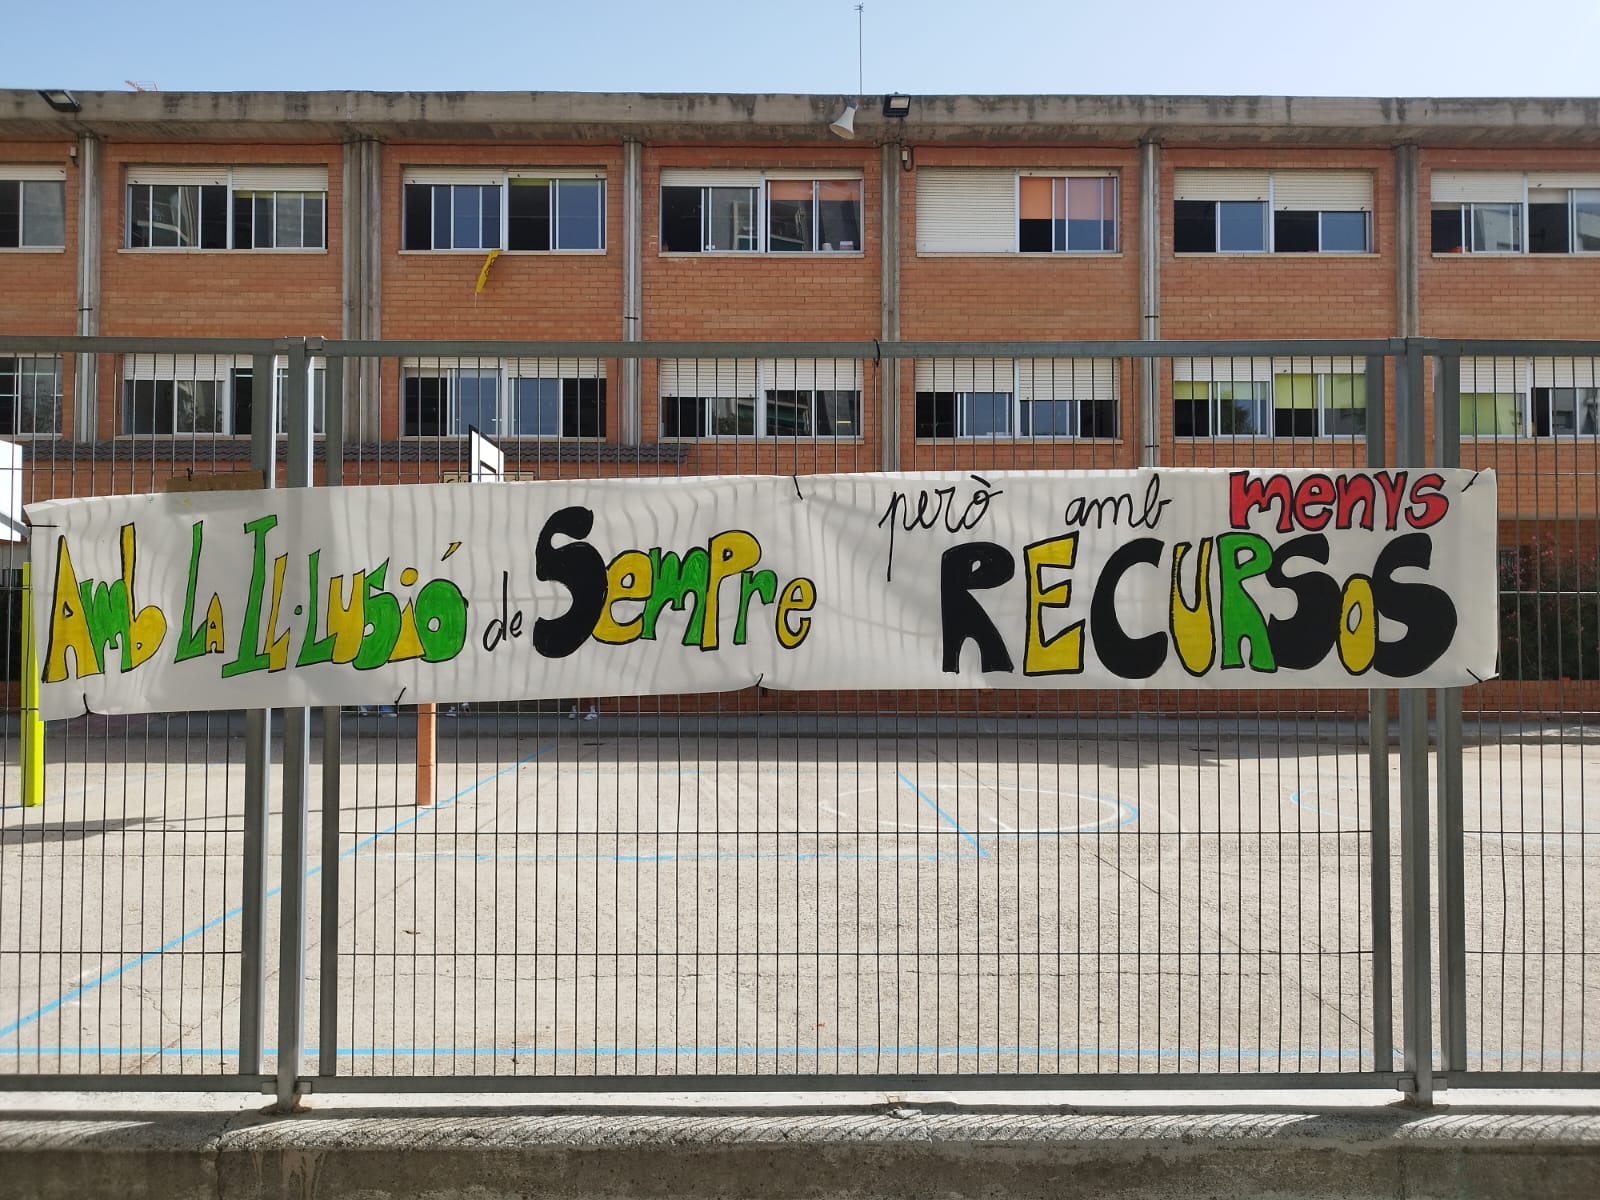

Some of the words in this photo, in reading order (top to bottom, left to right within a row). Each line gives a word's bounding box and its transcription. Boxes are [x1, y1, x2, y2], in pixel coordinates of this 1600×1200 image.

[41, 522, 168, 683] Amb
[482, 570, 523, 652] de
[878, 474, 1004, 583] però
[1065, 473, 1172, 529] amb
[941, 530, 1458, 680] RECURSOS
